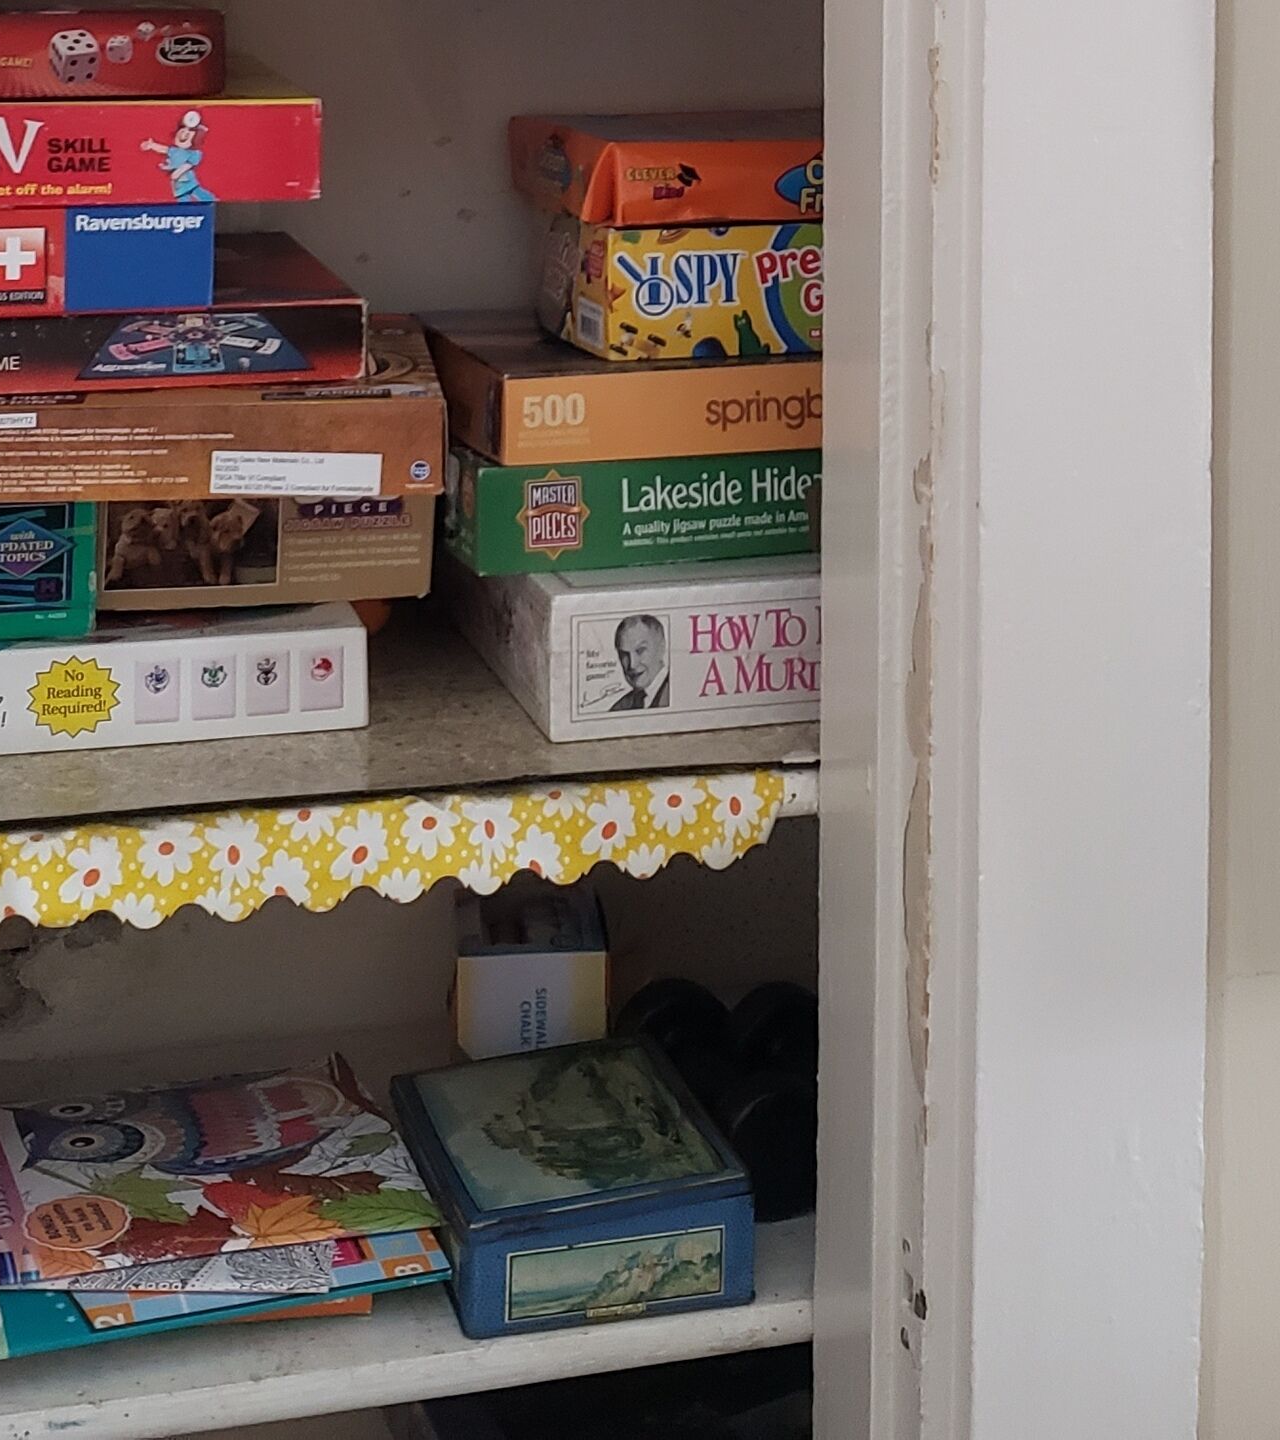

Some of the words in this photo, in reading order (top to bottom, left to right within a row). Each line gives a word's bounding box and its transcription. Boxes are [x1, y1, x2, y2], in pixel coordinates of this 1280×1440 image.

[47, 138, 111, 155] SKILL
[47, 157, 111, 173] GAME
[625, 167, 677, 181] CLEVER
[17, 183, 38, 196] off
[41, 183, 63, 196] the
[66, 183, 113, 196] alarm!
[74, 213, 206, 234] Ravensburger
[522, 392, 586, 428] 500
[531, 483, 575, 507] MASTER
[622, 469, 743, 514] Lakeside
[314, 502, 388, 515] PIECE
[531, 513, 576, 541] PIECES
[622, 522, 632, 536] A
[634, 519, 671, 539] quality
[709, 514, 741, 532] puzzle
[744, 513, 774, 527] made
[775, 512, 786, 525] in
[10, 530, 36, 541] with
[64, 668, 85, 683] No
[46, 683, 103, 702] Reading
[41, 699, 108, 718] Required!
